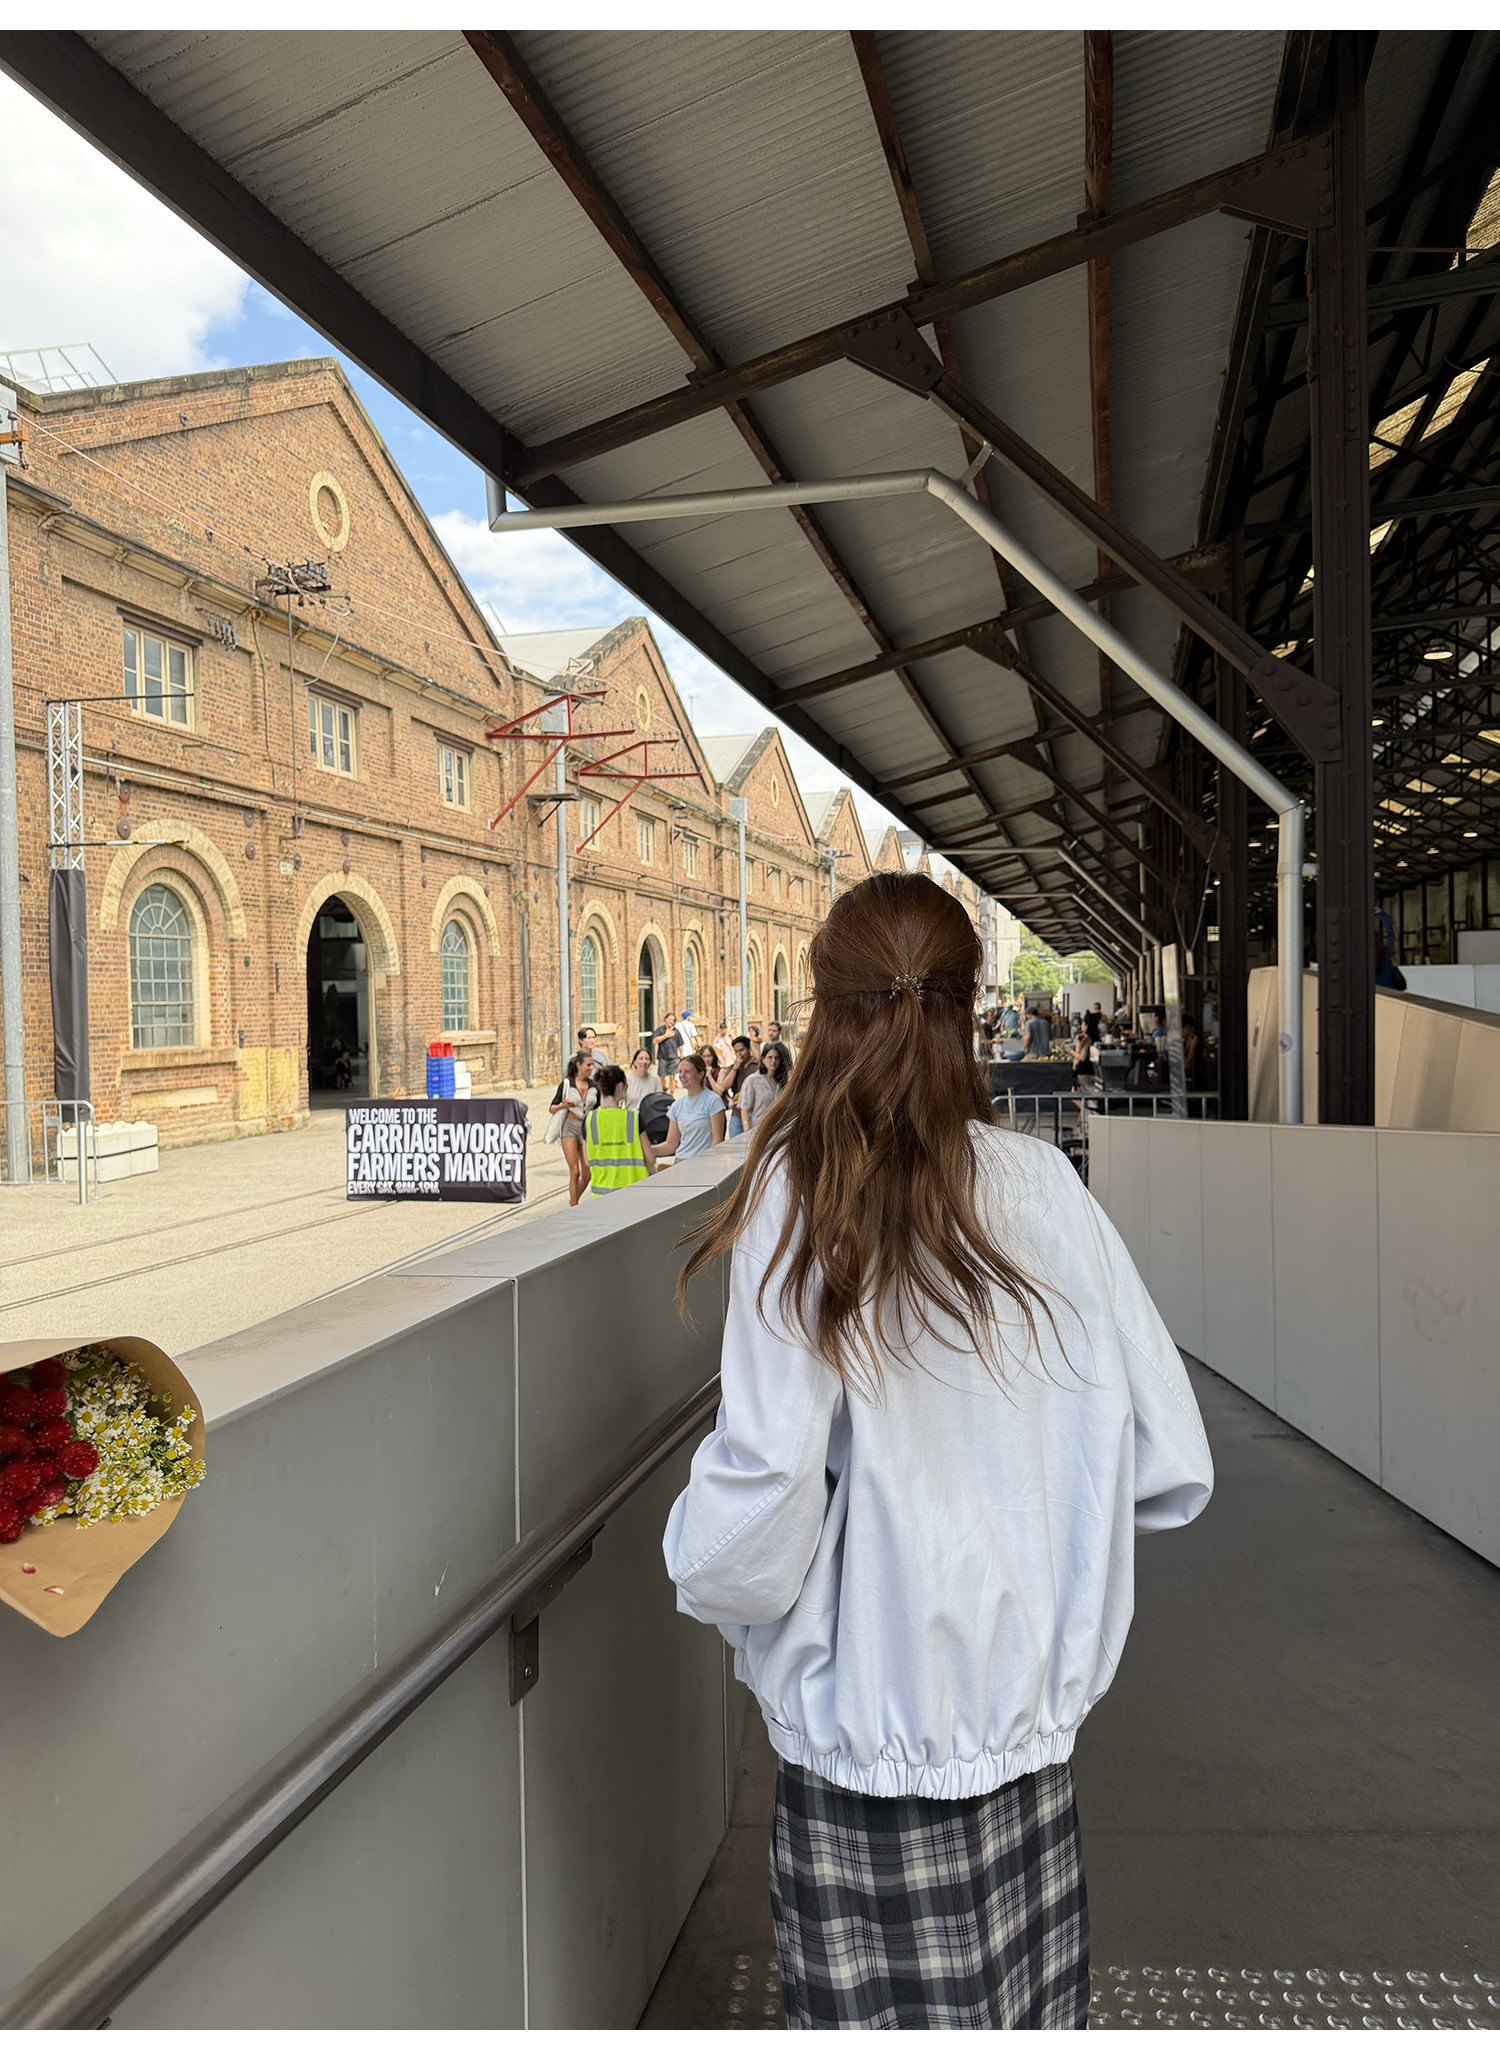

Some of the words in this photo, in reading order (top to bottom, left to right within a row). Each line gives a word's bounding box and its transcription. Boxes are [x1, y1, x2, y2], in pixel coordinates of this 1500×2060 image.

[348, 1108, 400, 1124] WELCOME
[401, 1108, 415, 1124] TO
[416, 1108, 438, 1124] THE
[347, 1123, 524, 1153] CARRIAGEWORKS
[347, 1152, 440, 1181] FARMERS
[444, 1153, 523, 1183] MARKET
[347, 1181, 376, 1195] EVERY
[376, 1181, 396, 1195] SAT,
